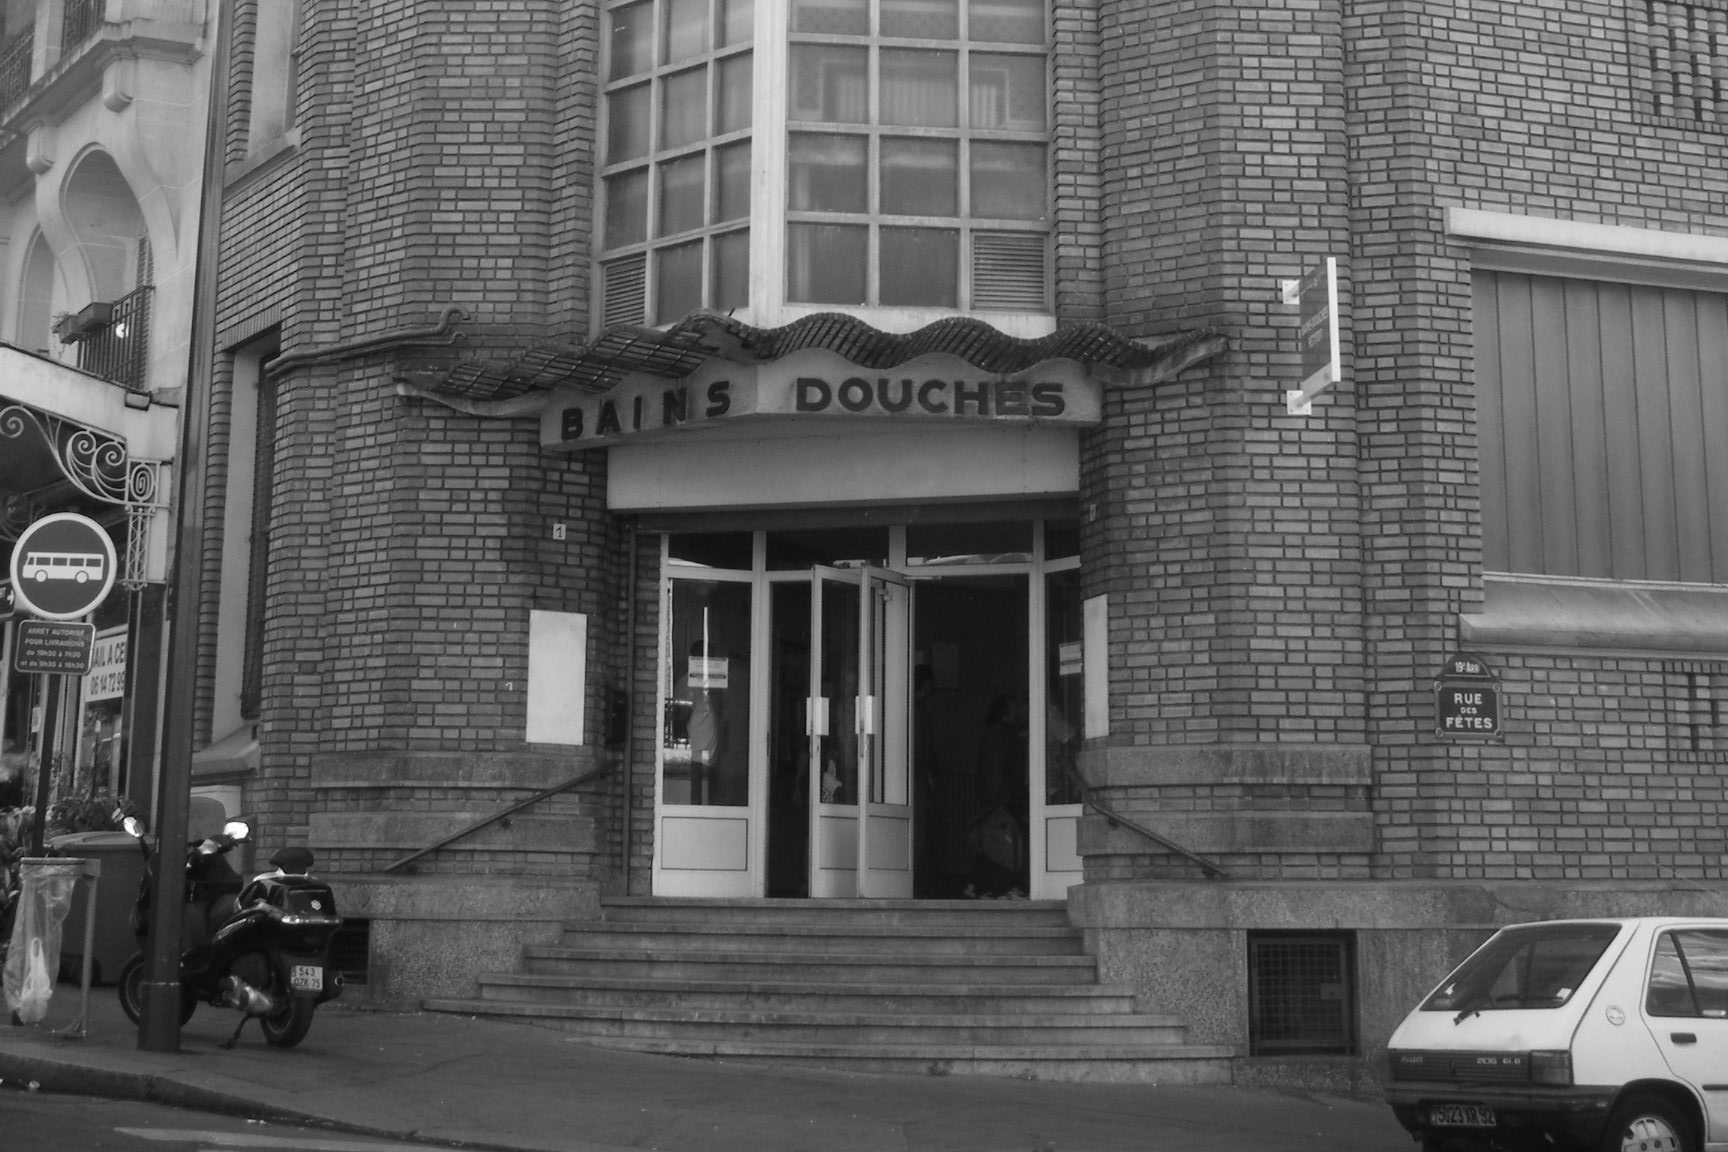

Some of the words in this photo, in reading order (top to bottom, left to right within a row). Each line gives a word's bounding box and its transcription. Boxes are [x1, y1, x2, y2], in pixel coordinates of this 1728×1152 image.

[560, 379, 732, 442] BAINS
[795, 377, 1066, 417] DOUCHES
[25, 638, 44, 646] POUR
[44, 639, 86, 648] LIVRAISONS
[1454, 693, 1482, 705] RUE
[1446, 714, 1493, 729] FÊTES
